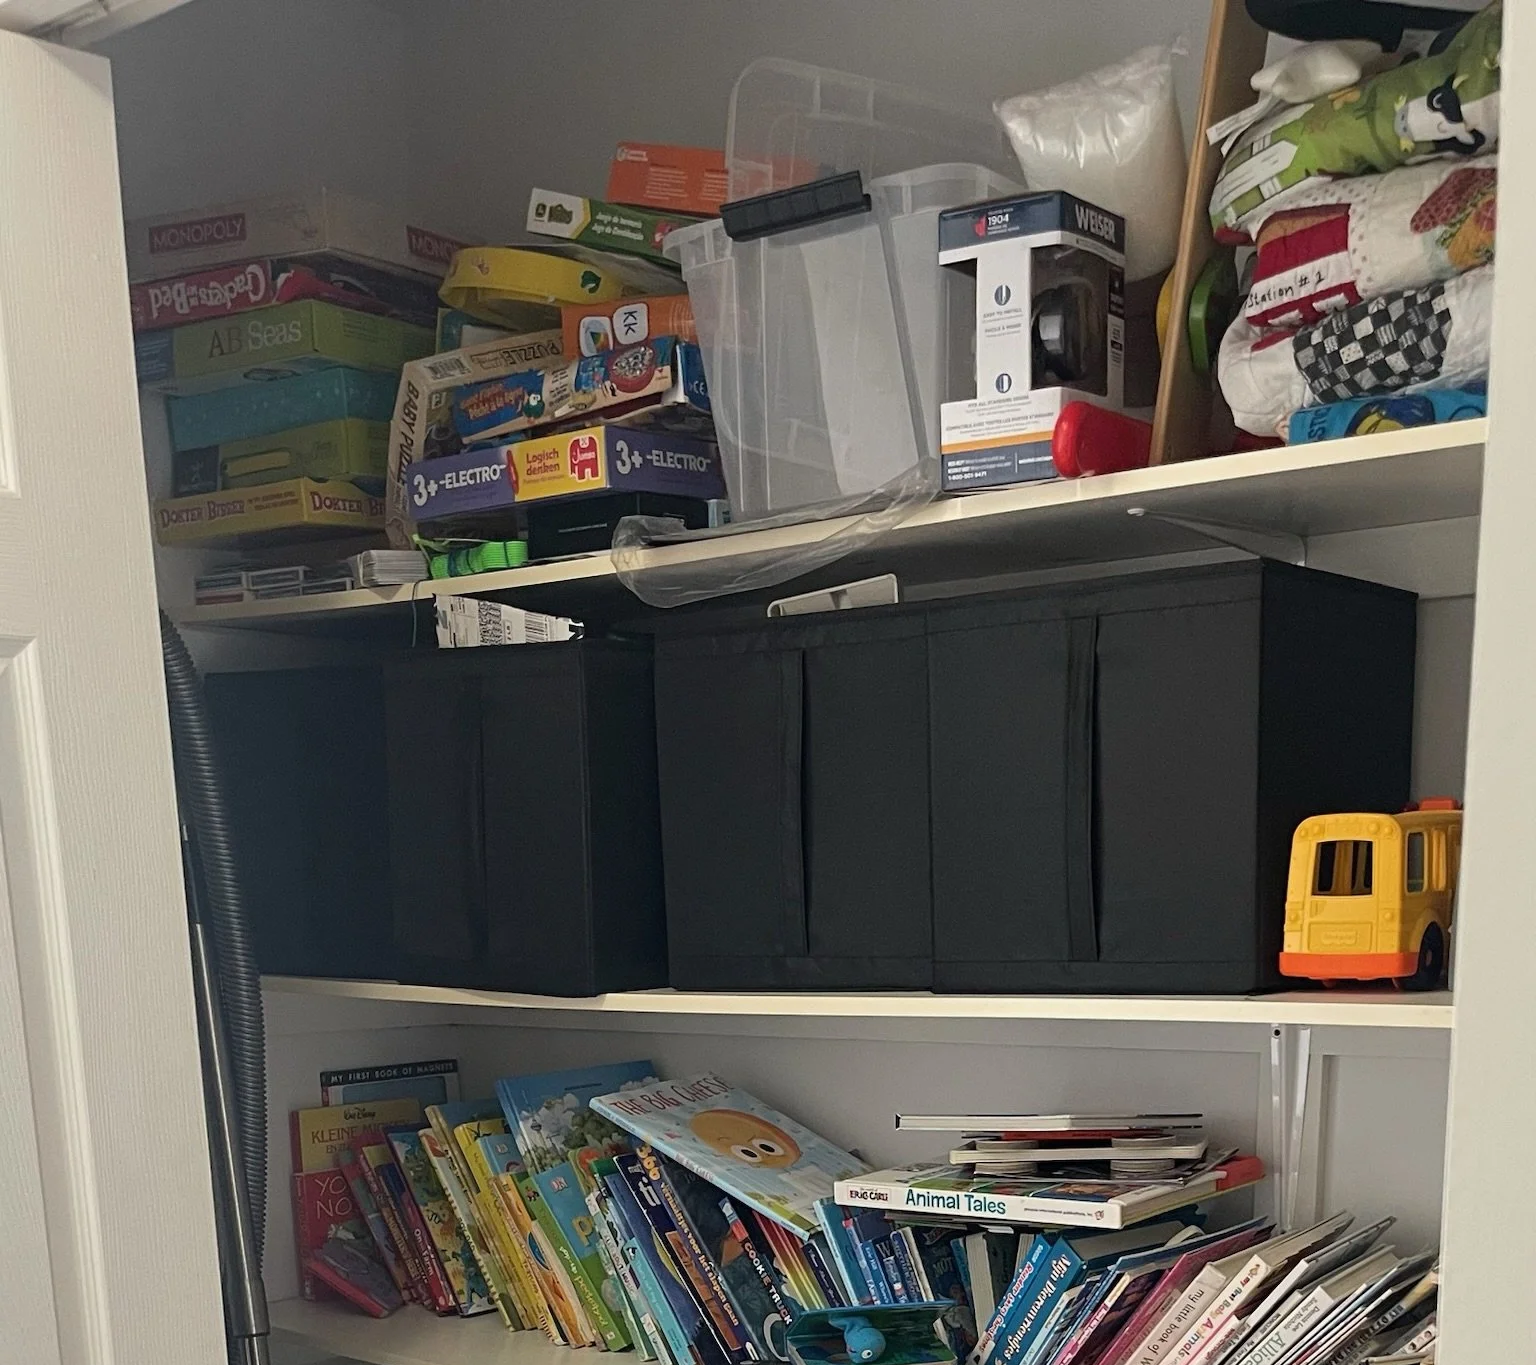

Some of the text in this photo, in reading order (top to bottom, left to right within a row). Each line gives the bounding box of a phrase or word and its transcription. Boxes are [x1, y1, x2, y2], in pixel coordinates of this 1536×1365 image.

[986, 213, 1010, 226] 1904
[1075, 204, 1116, 244] WEISER
[152, 217, 243, 250] MONOPOLY
[147, 282, 190, 320] Bed
[1246, 285, 1295, 308] Station
[503, 341, 562, 366] PUZZLE
[402, 379, 420, 436] BABY
[525, 447, 560, 466] Logisch
[525, 460, 560, 476] denken
[615, 439, 644, 475] 3+
[309, 491, 363, 514] DOKTER
[413, 474, 439, 506] 3+
[330, 1075, 344, 1084] MY
[348, 1070, 371, 1081] FIRST
[374, 1069, 398, 1079] BOOK
[610, 1075, 736, 1117] THE BIG CHEESE
[311, 1125, 358, 1145] KLEINE
[849, 1189, 870, 1200] ERIC
[905, 1188, 960, 1210] Animal
[964, 1194, 1007, 1215] Tales
[634, 1142, 665, 1182] 366
[684, 1232, 702, 1256] voor
[696, 1254, 712, 1273] het
[704, 1271, 728, 1303] slapen
[722, 1302, 740, 1326] gaan
[412, 1227, 424, 1243] On
[419, 1250, 437, 1276] Farm
[1046, 1252, 1073, 1284] Mijn
[740, 1241, 795, 1324] COOKIE TRUCK
[1187, 1286, 1205, 1304] my
[1227, 1285, 1242, 1301] first
[1000, 1277, 1056, 1363] Dierenvriendjes
[1174, 1302, 1195, 1325] little
[1208, 1297, 1231, 1321] Baby
[1291, 1304, 1320, 1334] Dennis Lee
[1156, 1322, 1178, 1346] book
[1176, 1316, 1215, 1360] Animals
[1146, 1341, 1161, 1355] of
[1235, 1346, 1247, 1359] First
